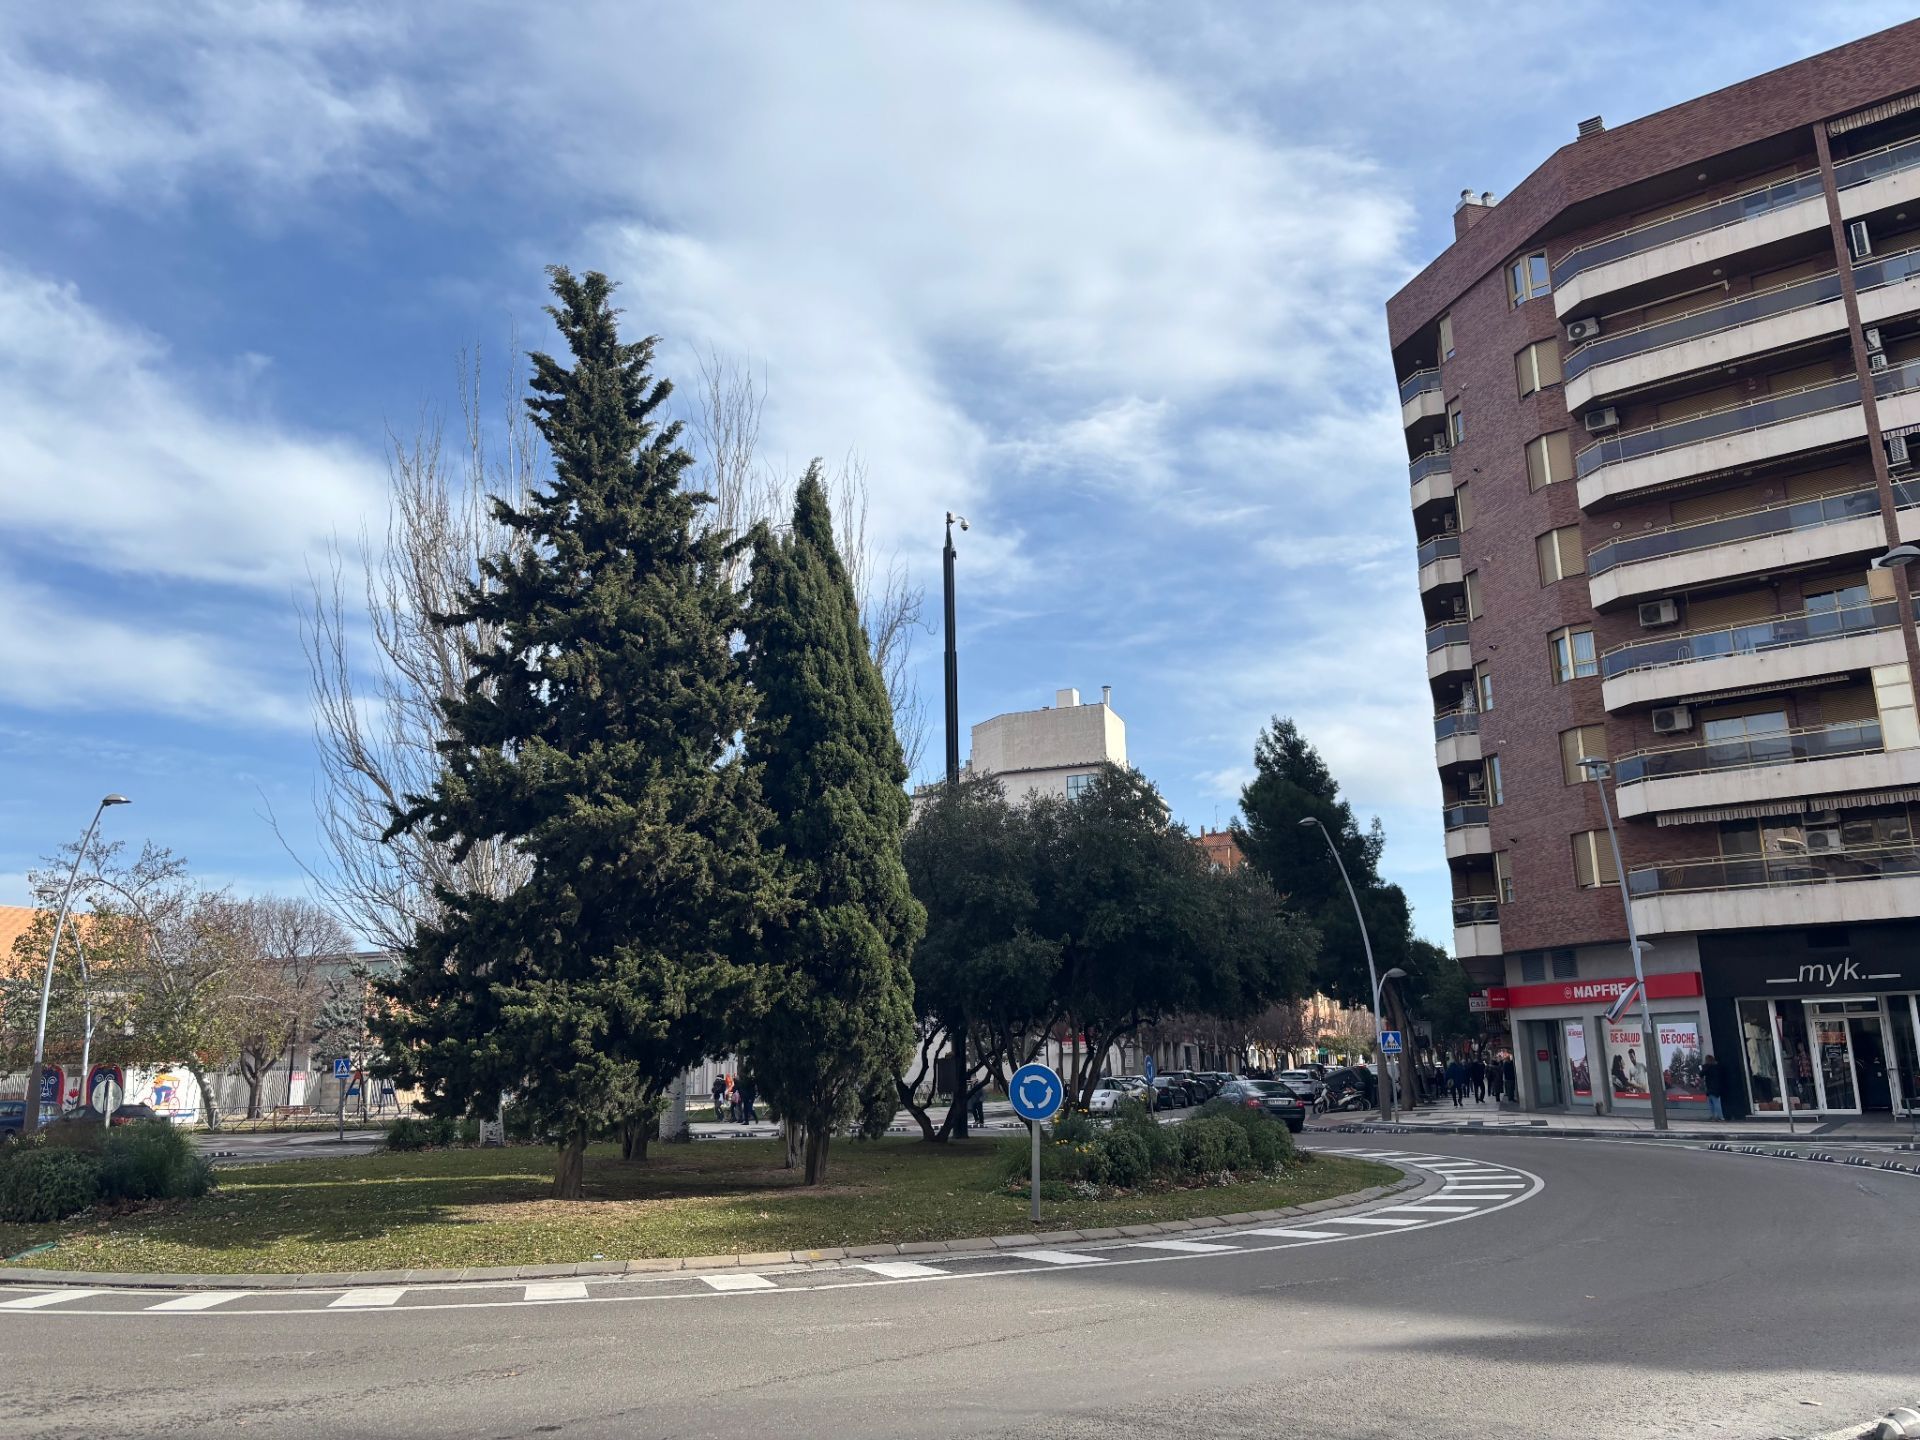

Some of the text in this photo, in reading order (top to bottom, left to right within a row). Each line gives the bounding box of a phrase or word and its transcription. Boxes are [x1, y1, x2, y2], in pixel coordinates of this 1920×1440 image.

[1573, 982, 1627, 998] MAPFRE
[1610, 1032, 1640, 1043] DE SALUD
[1661, 1033, 1696, 1044] DE COCHE
